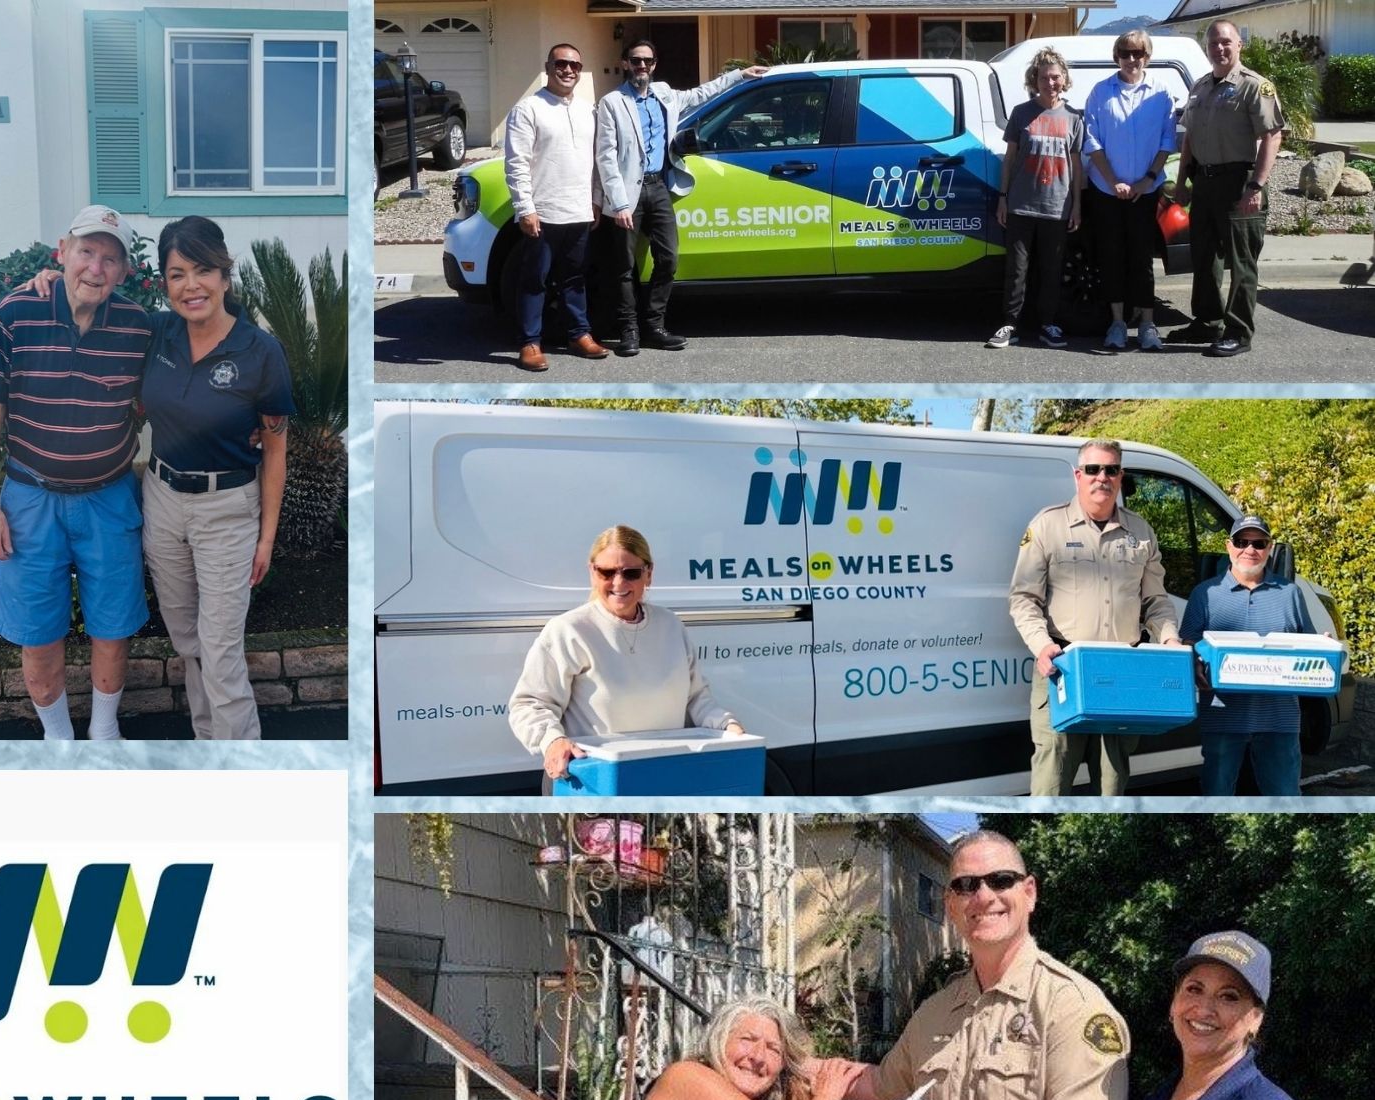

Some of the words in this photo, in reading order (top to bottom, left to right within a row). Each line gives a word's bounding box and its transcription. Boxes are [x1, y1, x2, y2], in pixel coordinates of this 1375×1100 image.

[1029, 134, 1066, 159] THE
[675, 205, 831, 228] 00.5.SENIOR
[839, 220, 896, 234] MEALS
[898, 222, 910, 230] on
[912, 217, 982, 232] WHEELS
[688, 227, 797, 239] meals-on-wheels.org
[856, 237, 878, 247] SAN
[882, 236, 916, 247] DIEGO
[919, 234, 965, 245] COUNTY
[689, 556, 803, 580] MEALS
[812, 560, 831, 571] on
[838, 554, 954, 575] WHEELS
[742, 586, 783, 601] SAN
[791, 586, 850, 601] DIEGO
[856, 586, 927, 599] COUNTY
[715, 645, 730, 659] to
[737, 642, 793, 658] receive
[799, 640, 847, 655] meals,
[852, 636, 899, 652] donate
[903, 638, 916, 649] or
[921, 632, 984, 648] volunteer!
[843, 656, 1036, 699] 800-5-SENIO
[397, 703, 511, 721] meals-on-w
